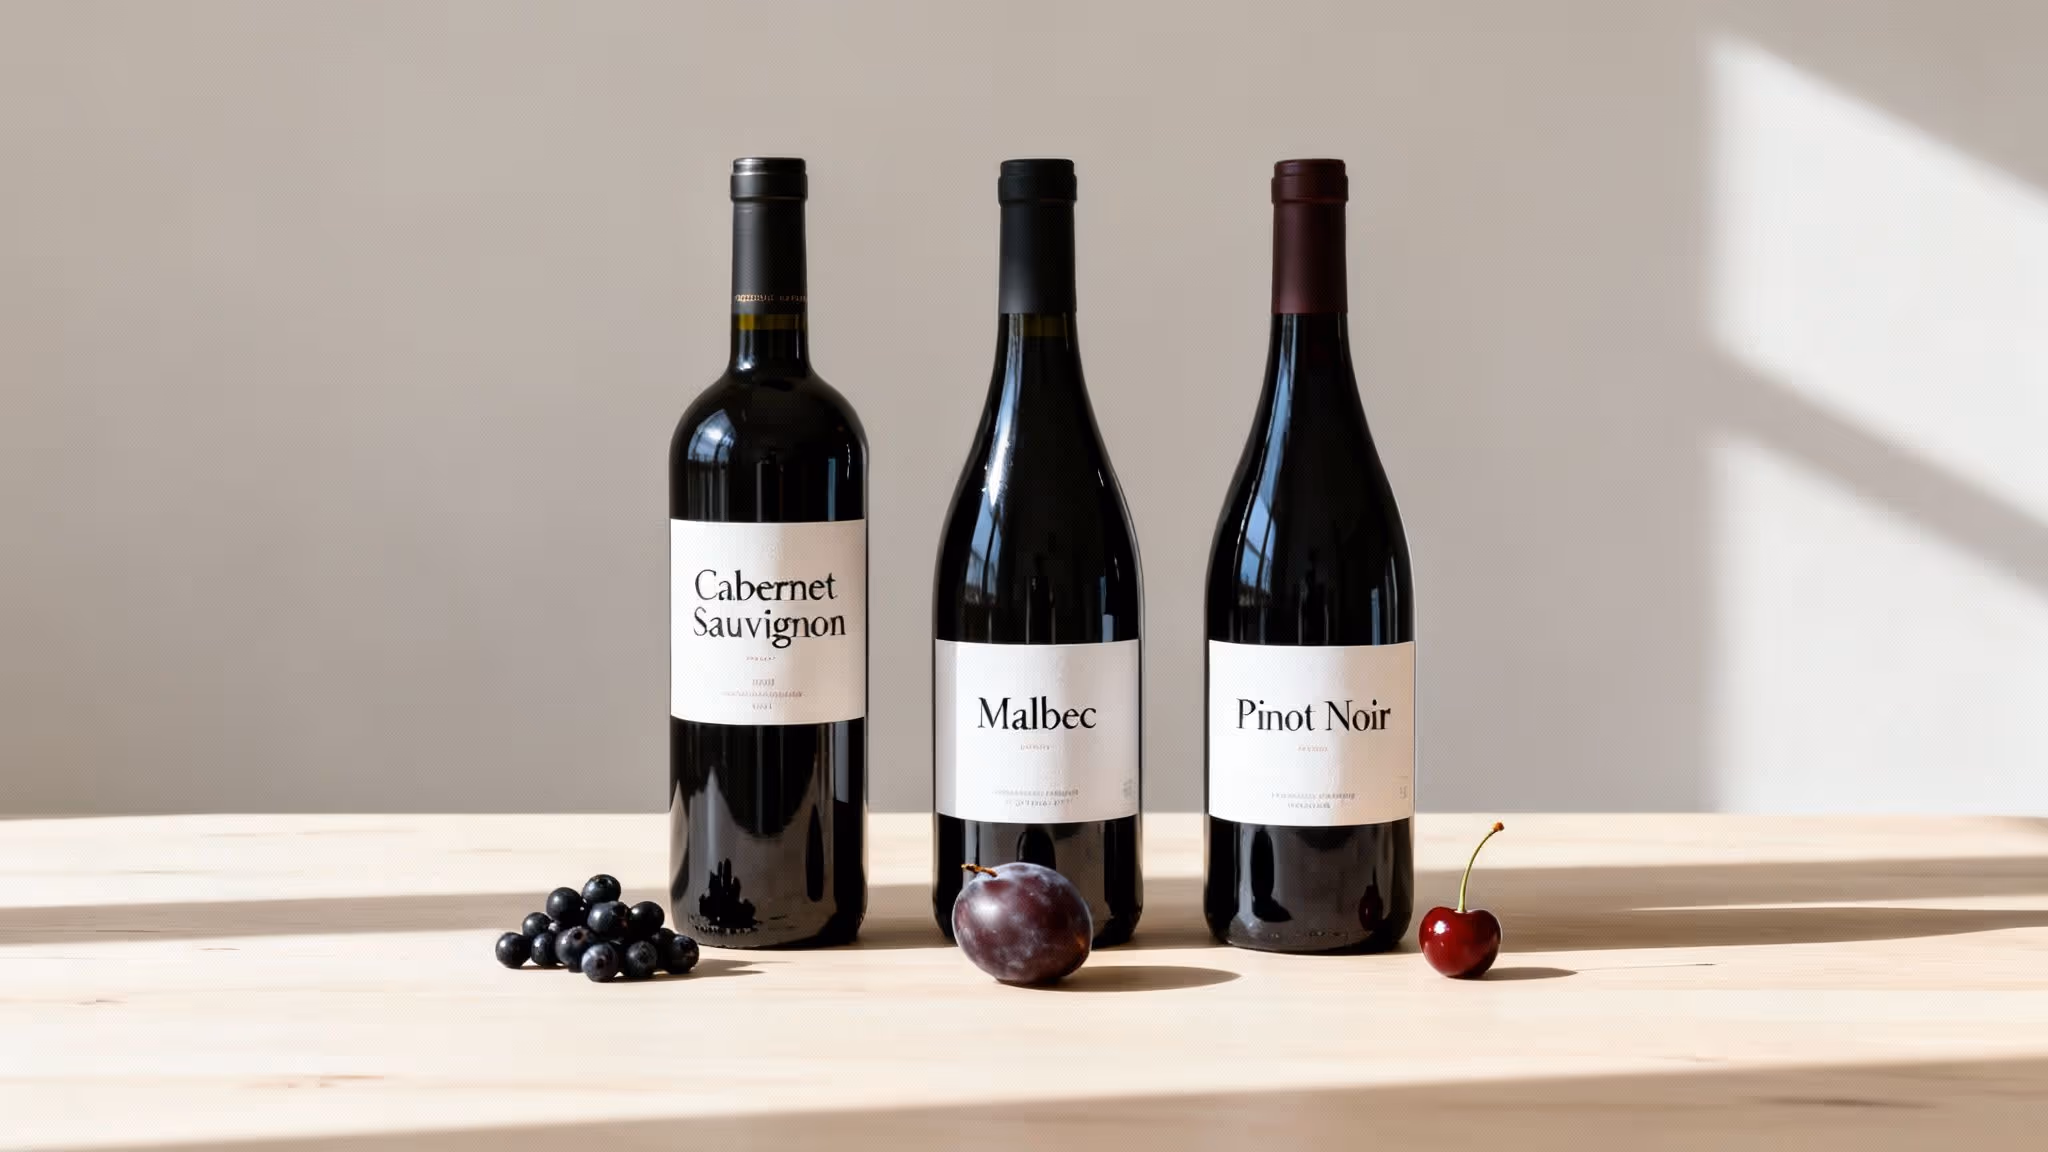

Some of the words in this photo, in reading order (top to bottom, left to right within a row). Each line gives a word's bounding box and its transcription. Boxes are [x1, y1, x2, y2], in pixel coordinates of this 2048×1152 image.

[695, 569, 838, 601] Cabernet
[693, 606, 847, 649] Sauvignon
[977, 696, 1097, 730] Malbec
[1236, 698, 1315, 731] Pinot
[1324, 699, 1391, 731] Noir
